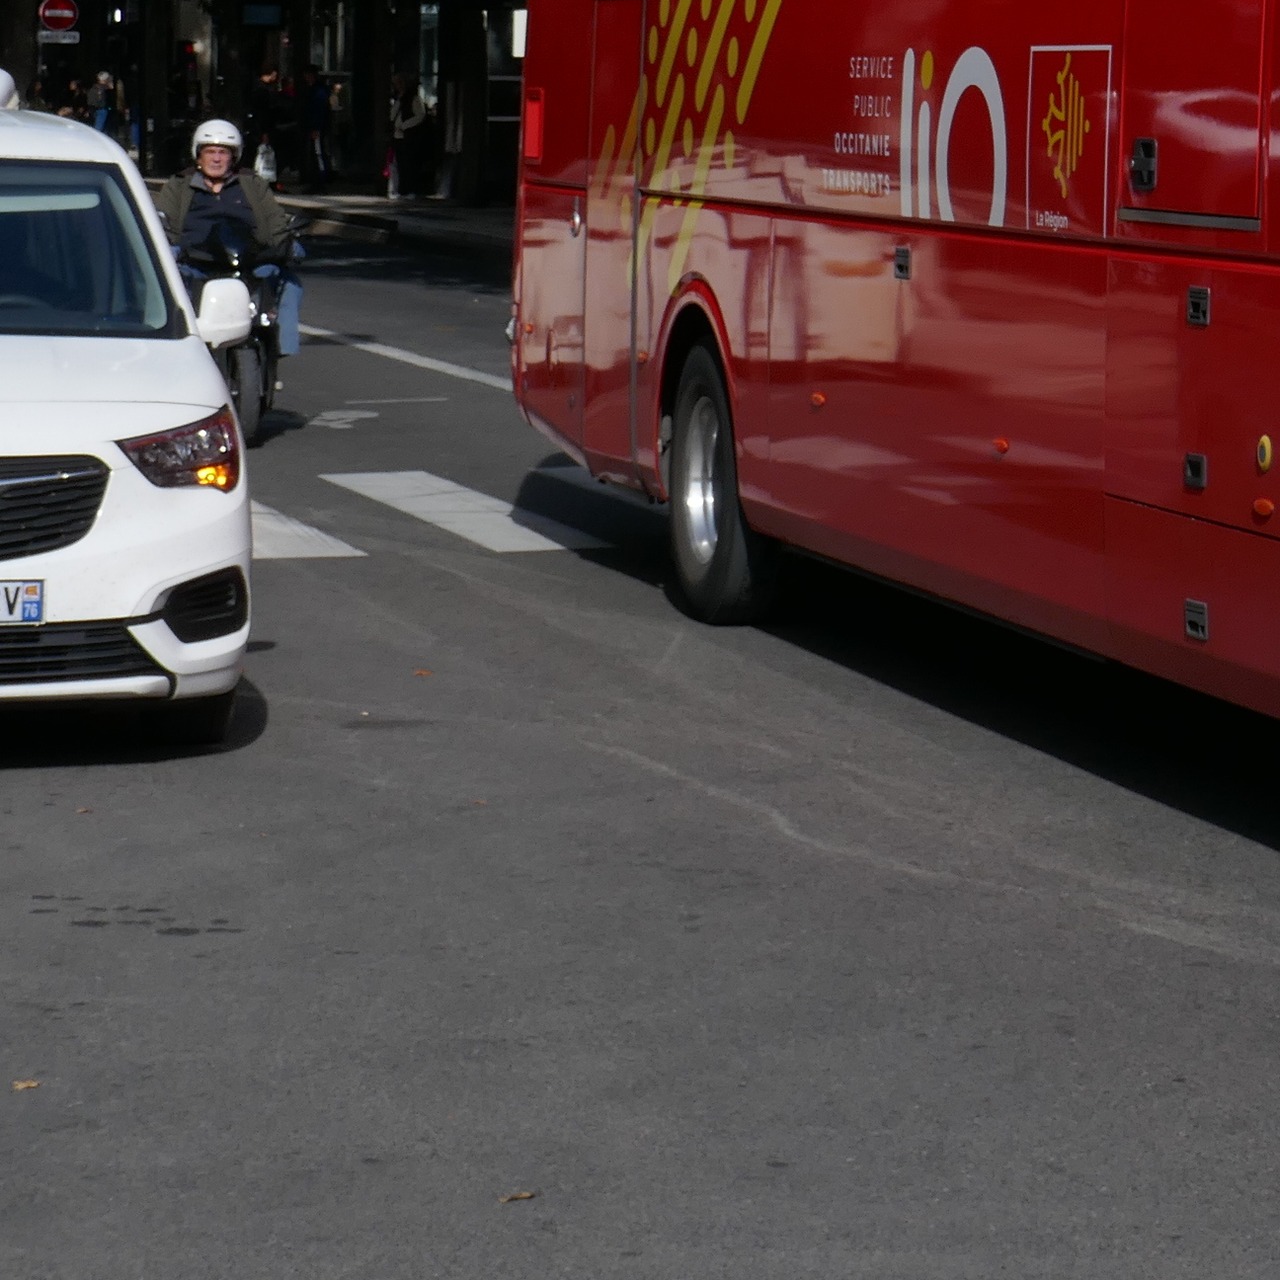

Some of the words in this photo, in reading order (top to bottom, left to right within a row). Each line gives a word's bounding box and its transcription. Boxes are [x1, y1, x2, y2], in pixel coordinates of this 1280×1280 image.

[849, 56, 894, 79] SERVICE
[853, 95, 892, 117] PUBLIC
[834, 132, 891, 157] OCCITANIE
[822, 169, 891, 196] TRANSPORTS
